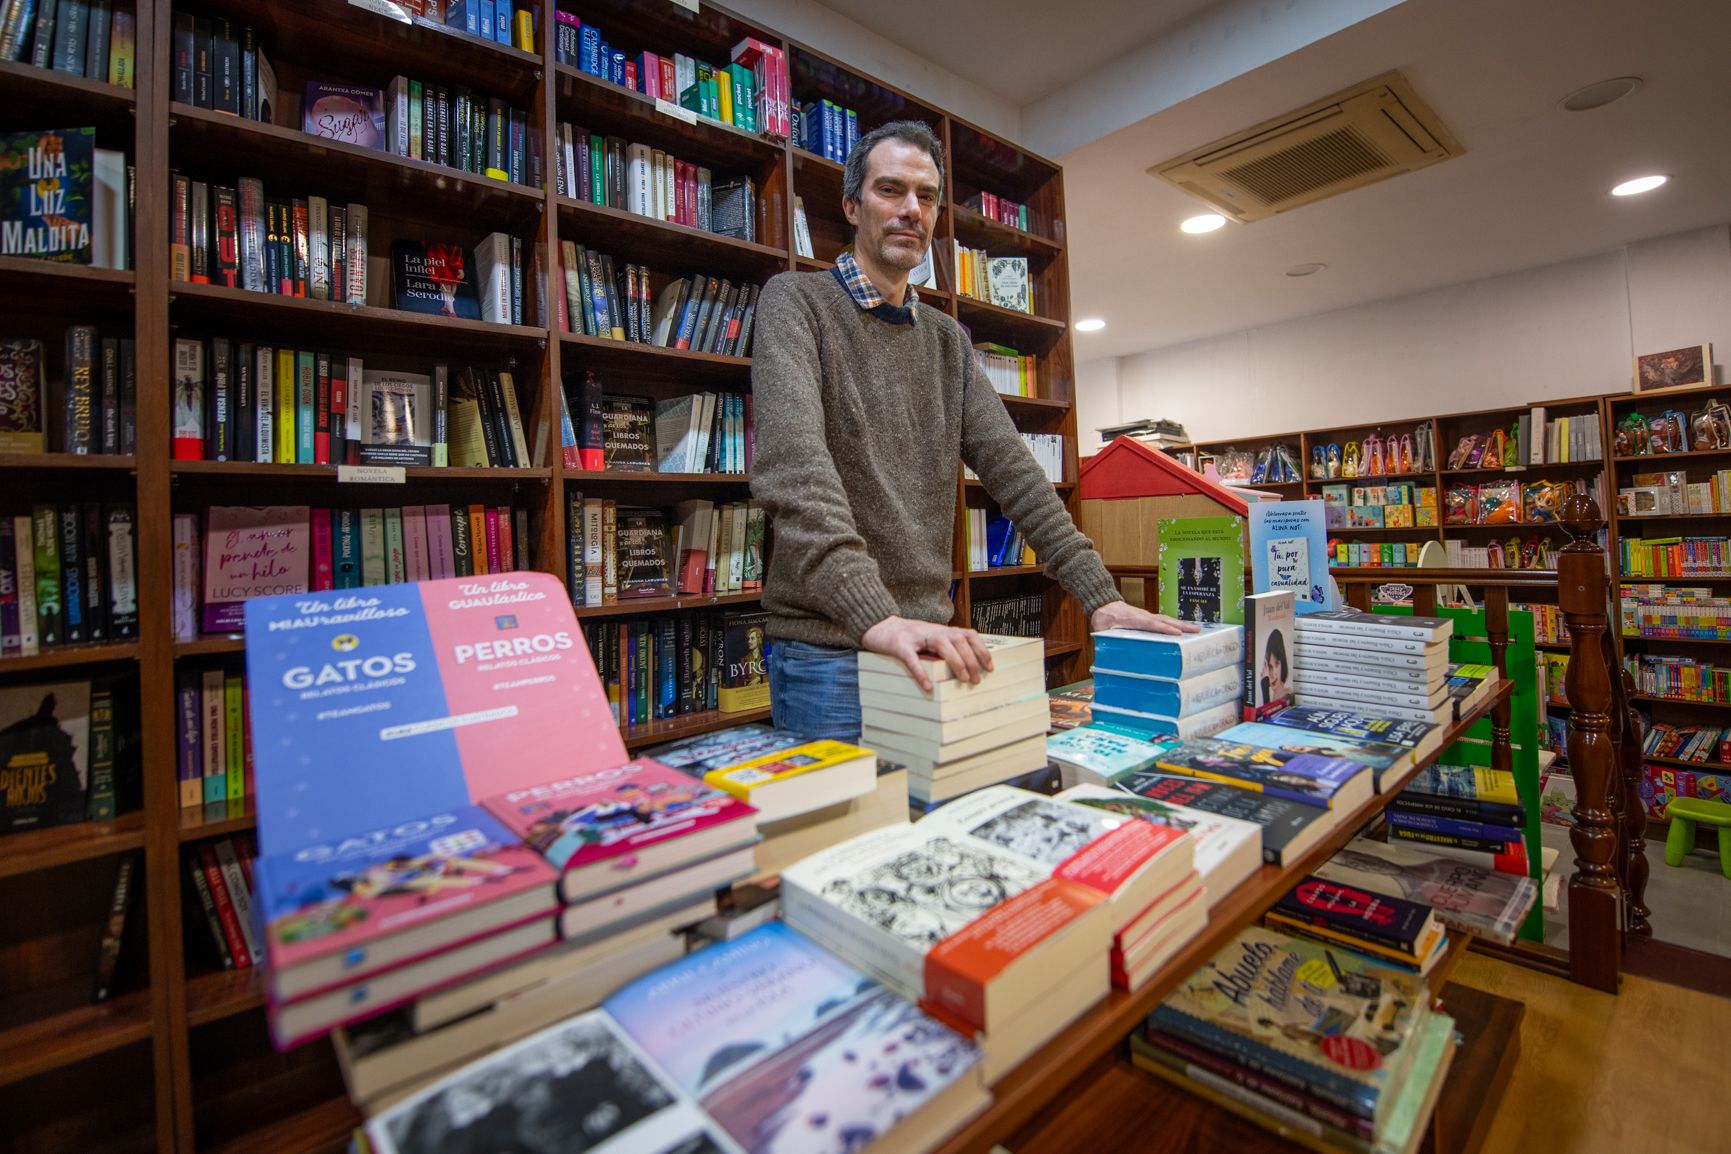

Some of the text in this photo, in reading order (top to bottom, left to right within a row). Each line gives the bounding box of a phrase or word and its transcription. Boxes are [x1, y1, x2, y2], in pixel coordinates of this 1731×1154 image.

[590, 30, 598, 75] CAMBRIDGE
[318, 84, 349, 95] ARANTXA
[791, 113, 800, 147] Oxford
[28, 147, 67, 179] UNA
[30, 183, 65, 216] LUZ
[1, 220, 90, 255] MALDITA
[404, 254, 446, 268] La piel
[406, 279, 436, 291] Lara
[303, 367, 312, 405] ROBIN COOK
[74, 366, 91, 442] REY BRUJO
[602, 412, 649, 422] GUARDIANA
[261, 423, 270, 455] ALQUIMISTA
[604, 441, 649, 451] QUEMADOS
[613, 432, 640, 440] LIBROS
[455, 508, 466, 556] Corrupt
[590, 513, 598, 555] MITOLOGÍA
[617, 529, 663, 537] GUARDIANA
[622, 558, 666, 567] QUEMADOS
[629, 548, 656, 556] LIBROS
[1286, 551, 1298, 561] por
[1270, 578, 1309, 587] casualidad
[1277, 564, 1297, 574] pura
[212, 584, 303, 599] LUCY SCORE
[490, 579, 530, 594] libro
[332, 596, 382, 613] libro
[454, 631, 574, 665] PERROS
[717, 630, 725, 667] BYRON
[282, 651, 417, 690] GATOS
[505, 763, 643, 802] PERROS
[296, 814, 457, 862] GATOS
[1211, 938, 1280, 1003] Abuelo,
